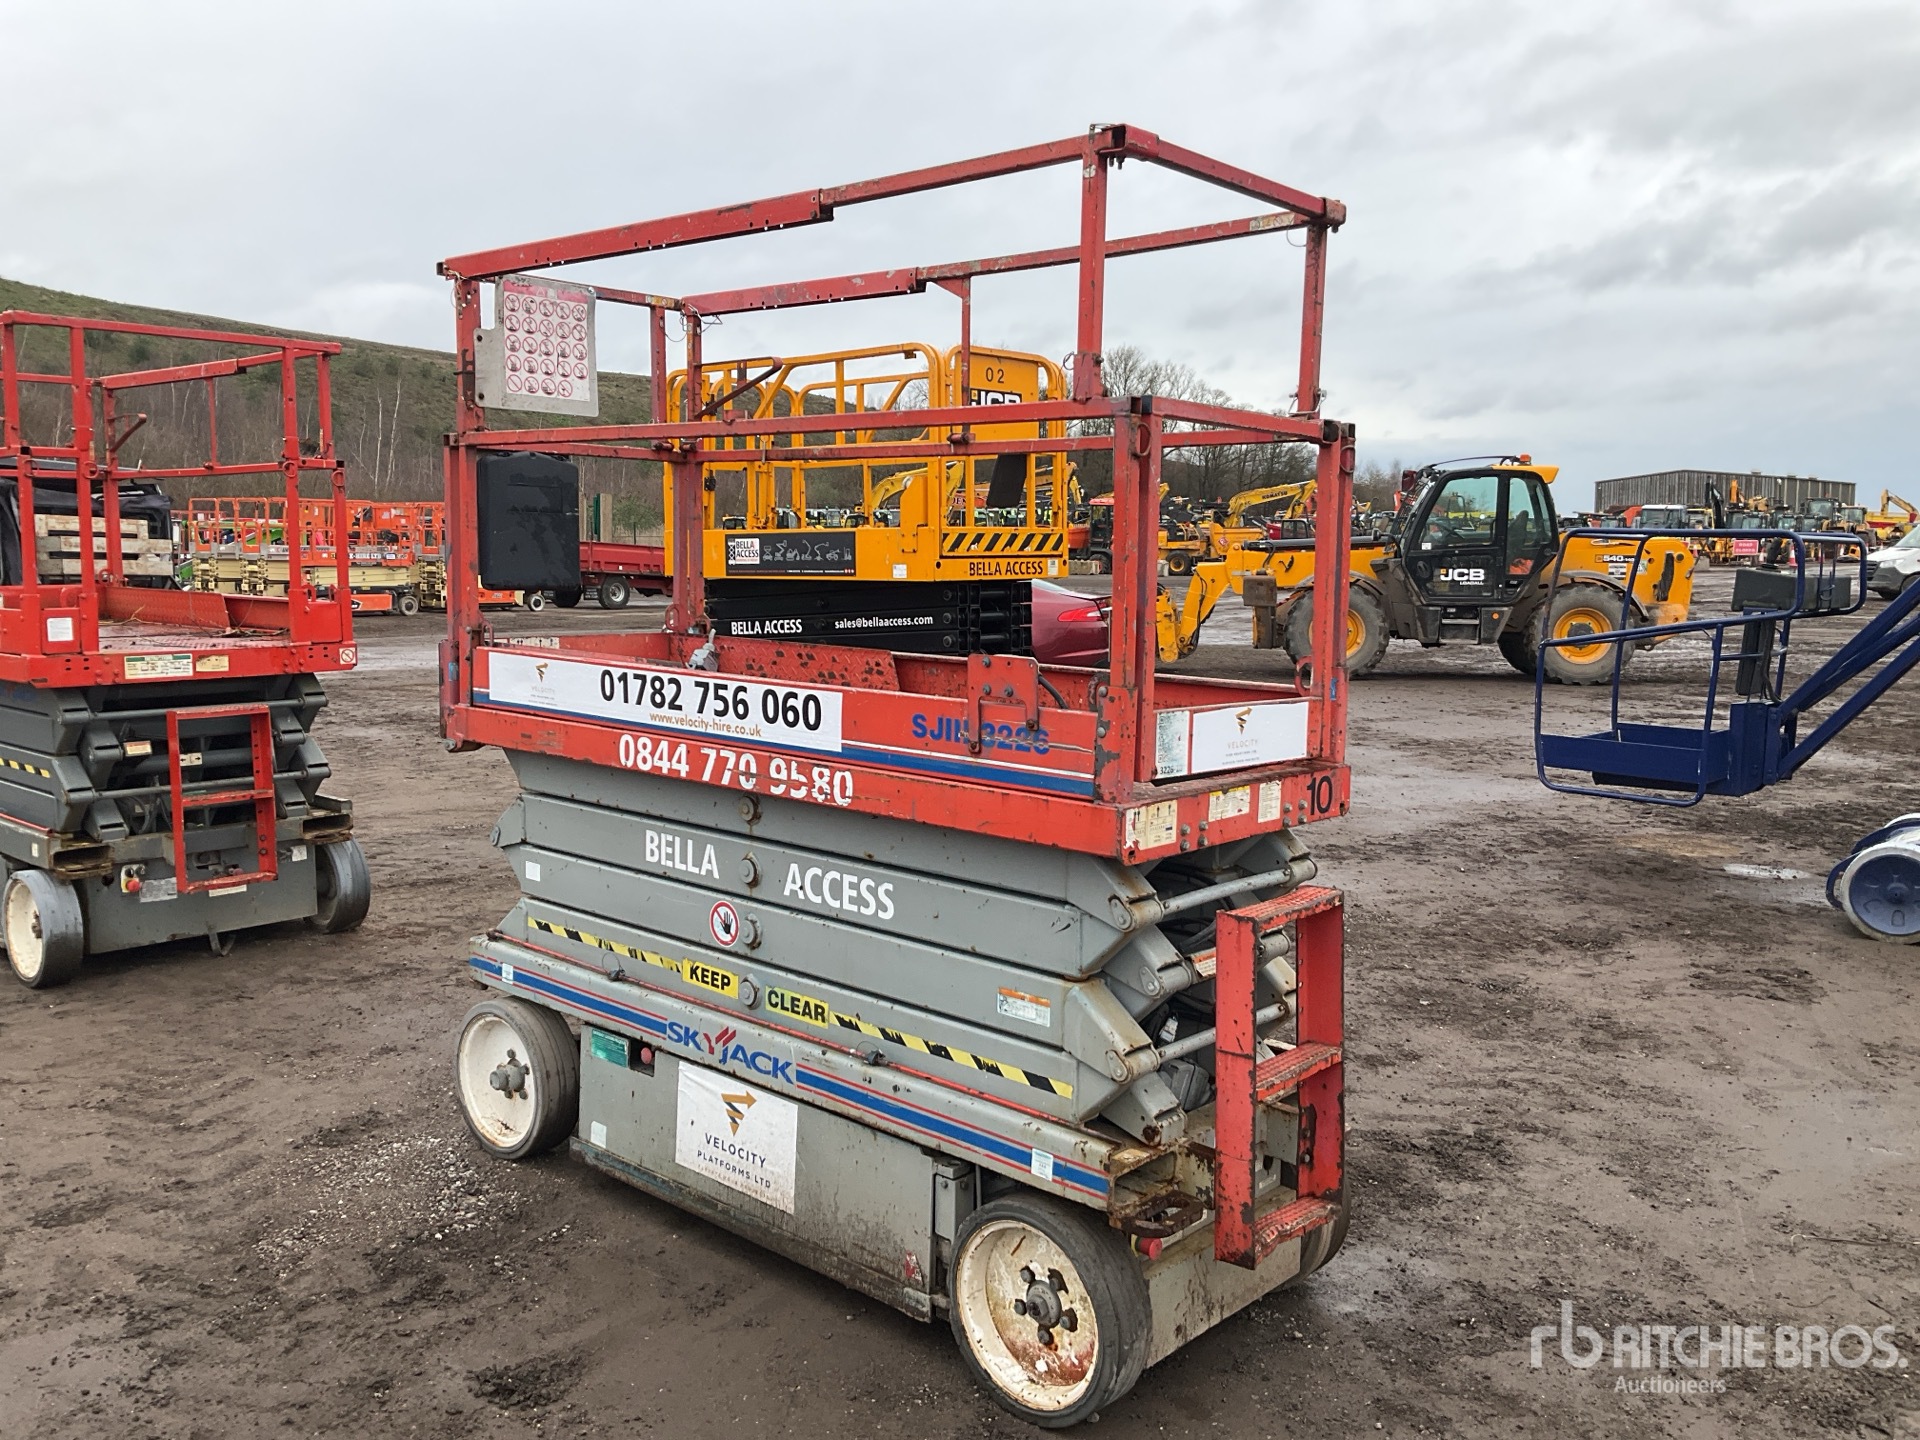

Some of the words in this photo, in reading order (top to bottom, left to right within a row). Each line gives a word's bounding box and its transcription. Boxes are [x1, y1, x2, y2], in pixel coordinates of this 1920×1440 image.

[736, 540, 755, 549] BELLA
[736, 549, 759, 558] ACCESS
[969, 562, 1002, 576] BELLA
[1005, 560, 1043, 575] ACCESS
[1440, 568, 1485, 581] JCB
[731, 620, 762, 635] BELLA
[764, 619, 802, 634] ACCESS
[835, 615, 933, 629] sales@bellaaccess.com
[600, 669, 683, 712] 01782
[694, 680, 749, 720] 756
[761, 689, 822, 731] 060
[650, 711, 762, 737] www.velocity-hire.co.uk
[981, 722, 1050, 755] 3226
[619, 734, 689, 778] 0844
[700, 747, 757, 790] 770
[769, 757, 853, 806] 9580
[1307, 776, 1333, 815] 10
[645, 830, 720, 879] BELLA
[783, 863, 895, 920] ACCESS
[690, 964, 731, 990] KEEP
[767, 990, 826, 1023] CLEAR
[667, 1021, 795, 1085] SKYJACK
[705, 1132, 766, 1168] VELOCITY
[697, 1150, 750, 1179] PLATFORMS
[754, 1175, 771, 1188] LTD
